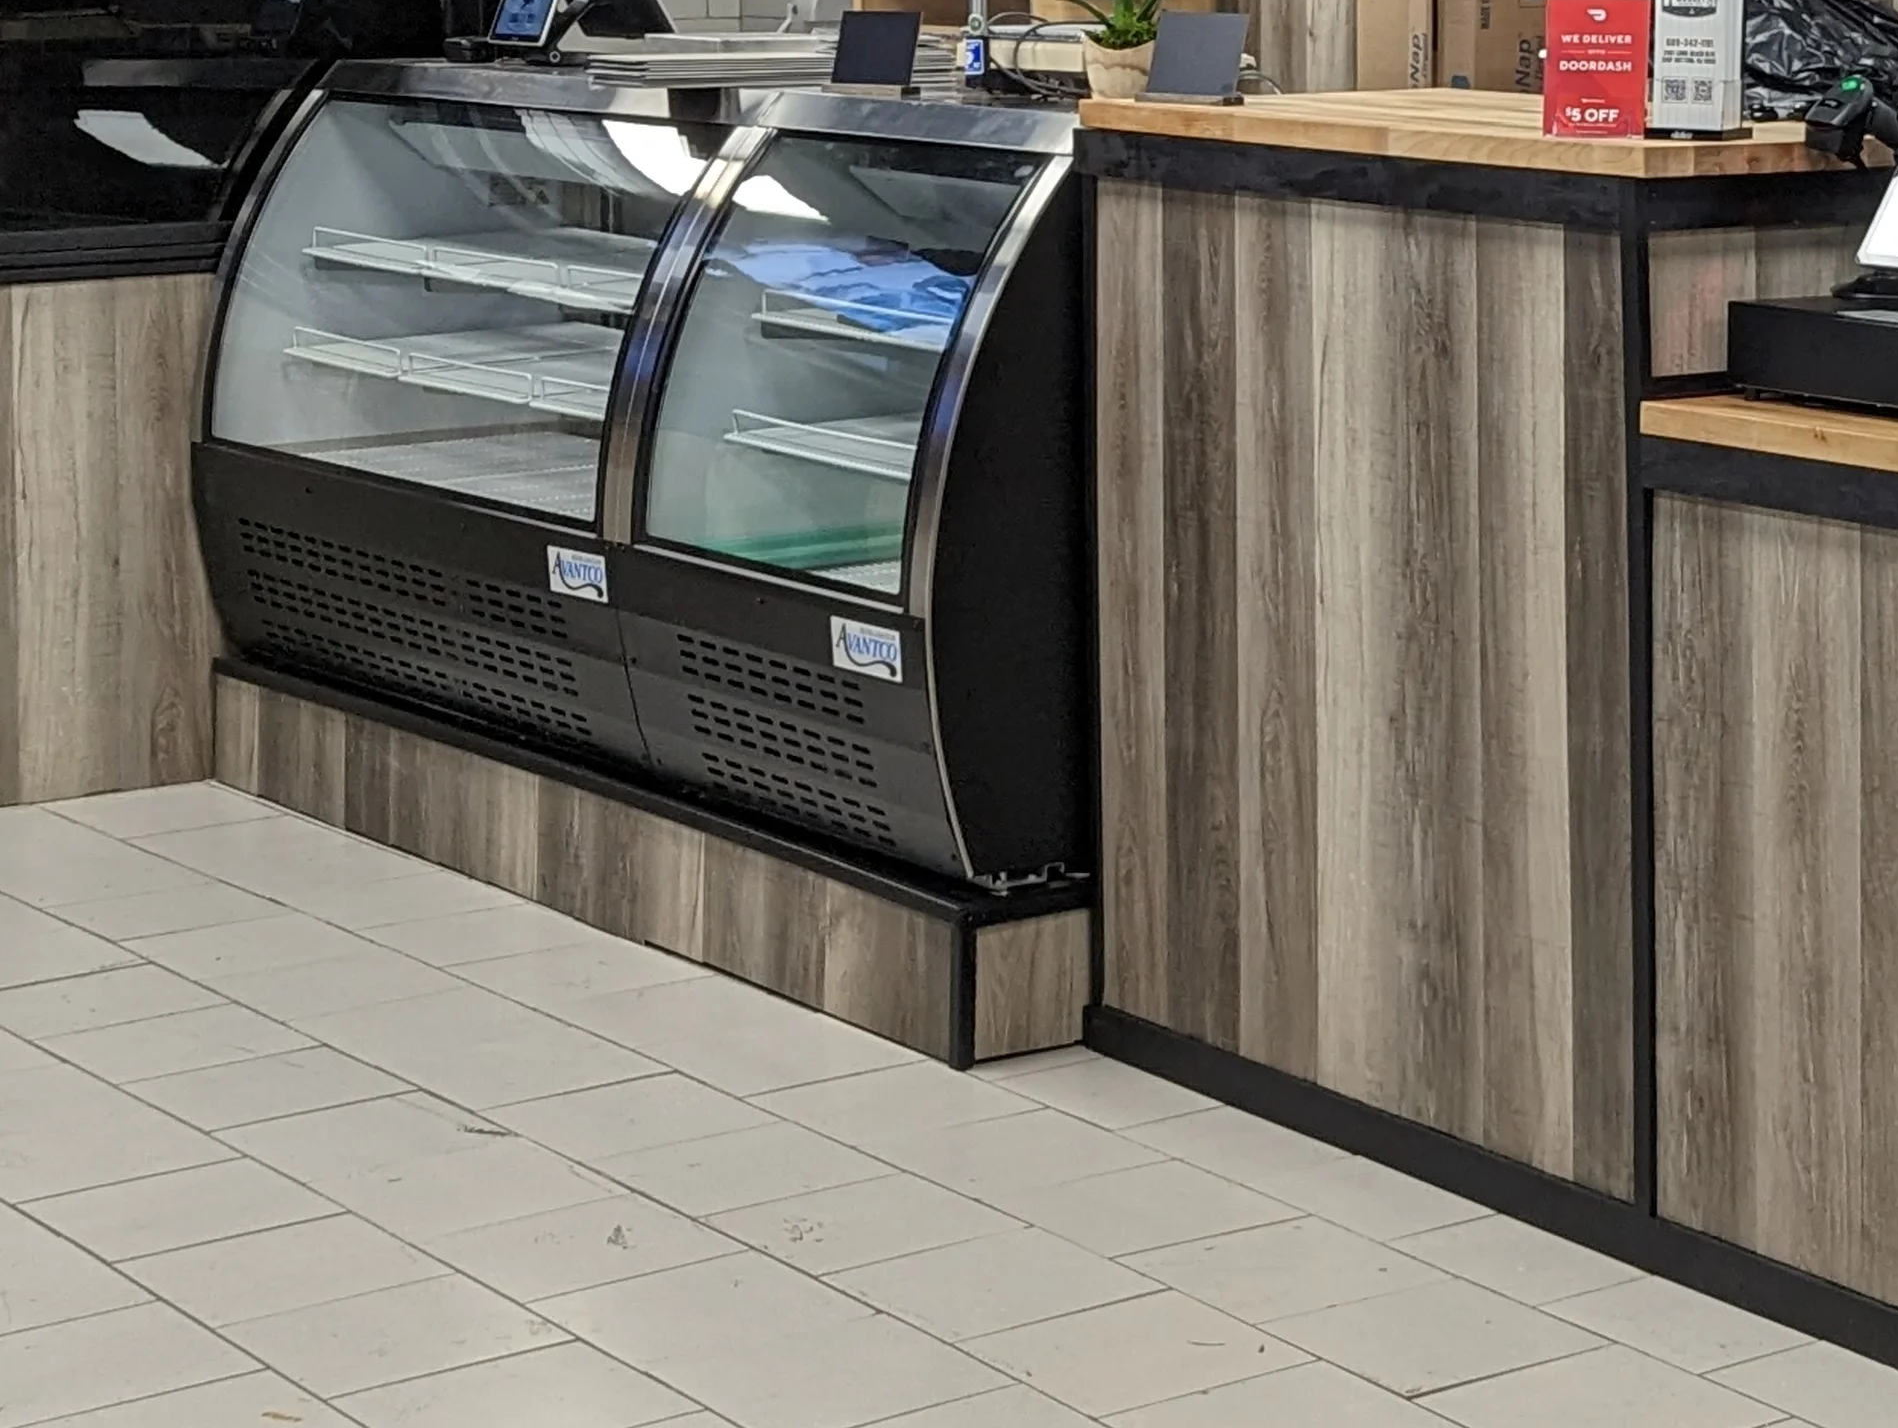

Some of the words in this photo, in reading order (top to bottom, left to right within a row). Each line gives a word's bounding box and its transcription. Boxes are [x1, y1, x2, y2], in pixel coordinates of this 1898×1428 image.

[1561, 35, 1580, 43] WE
[1582, 35, 1632, 44] DELIVER
[1559, 60, 1632, 71] DOORDASH
[1565, 107, 1581, 122] $5
[1584, 108, 1619, 122] OFF
[552, 551, 603, 586] AVANTCO
[836, 623, 898, 664] AVANTCO
